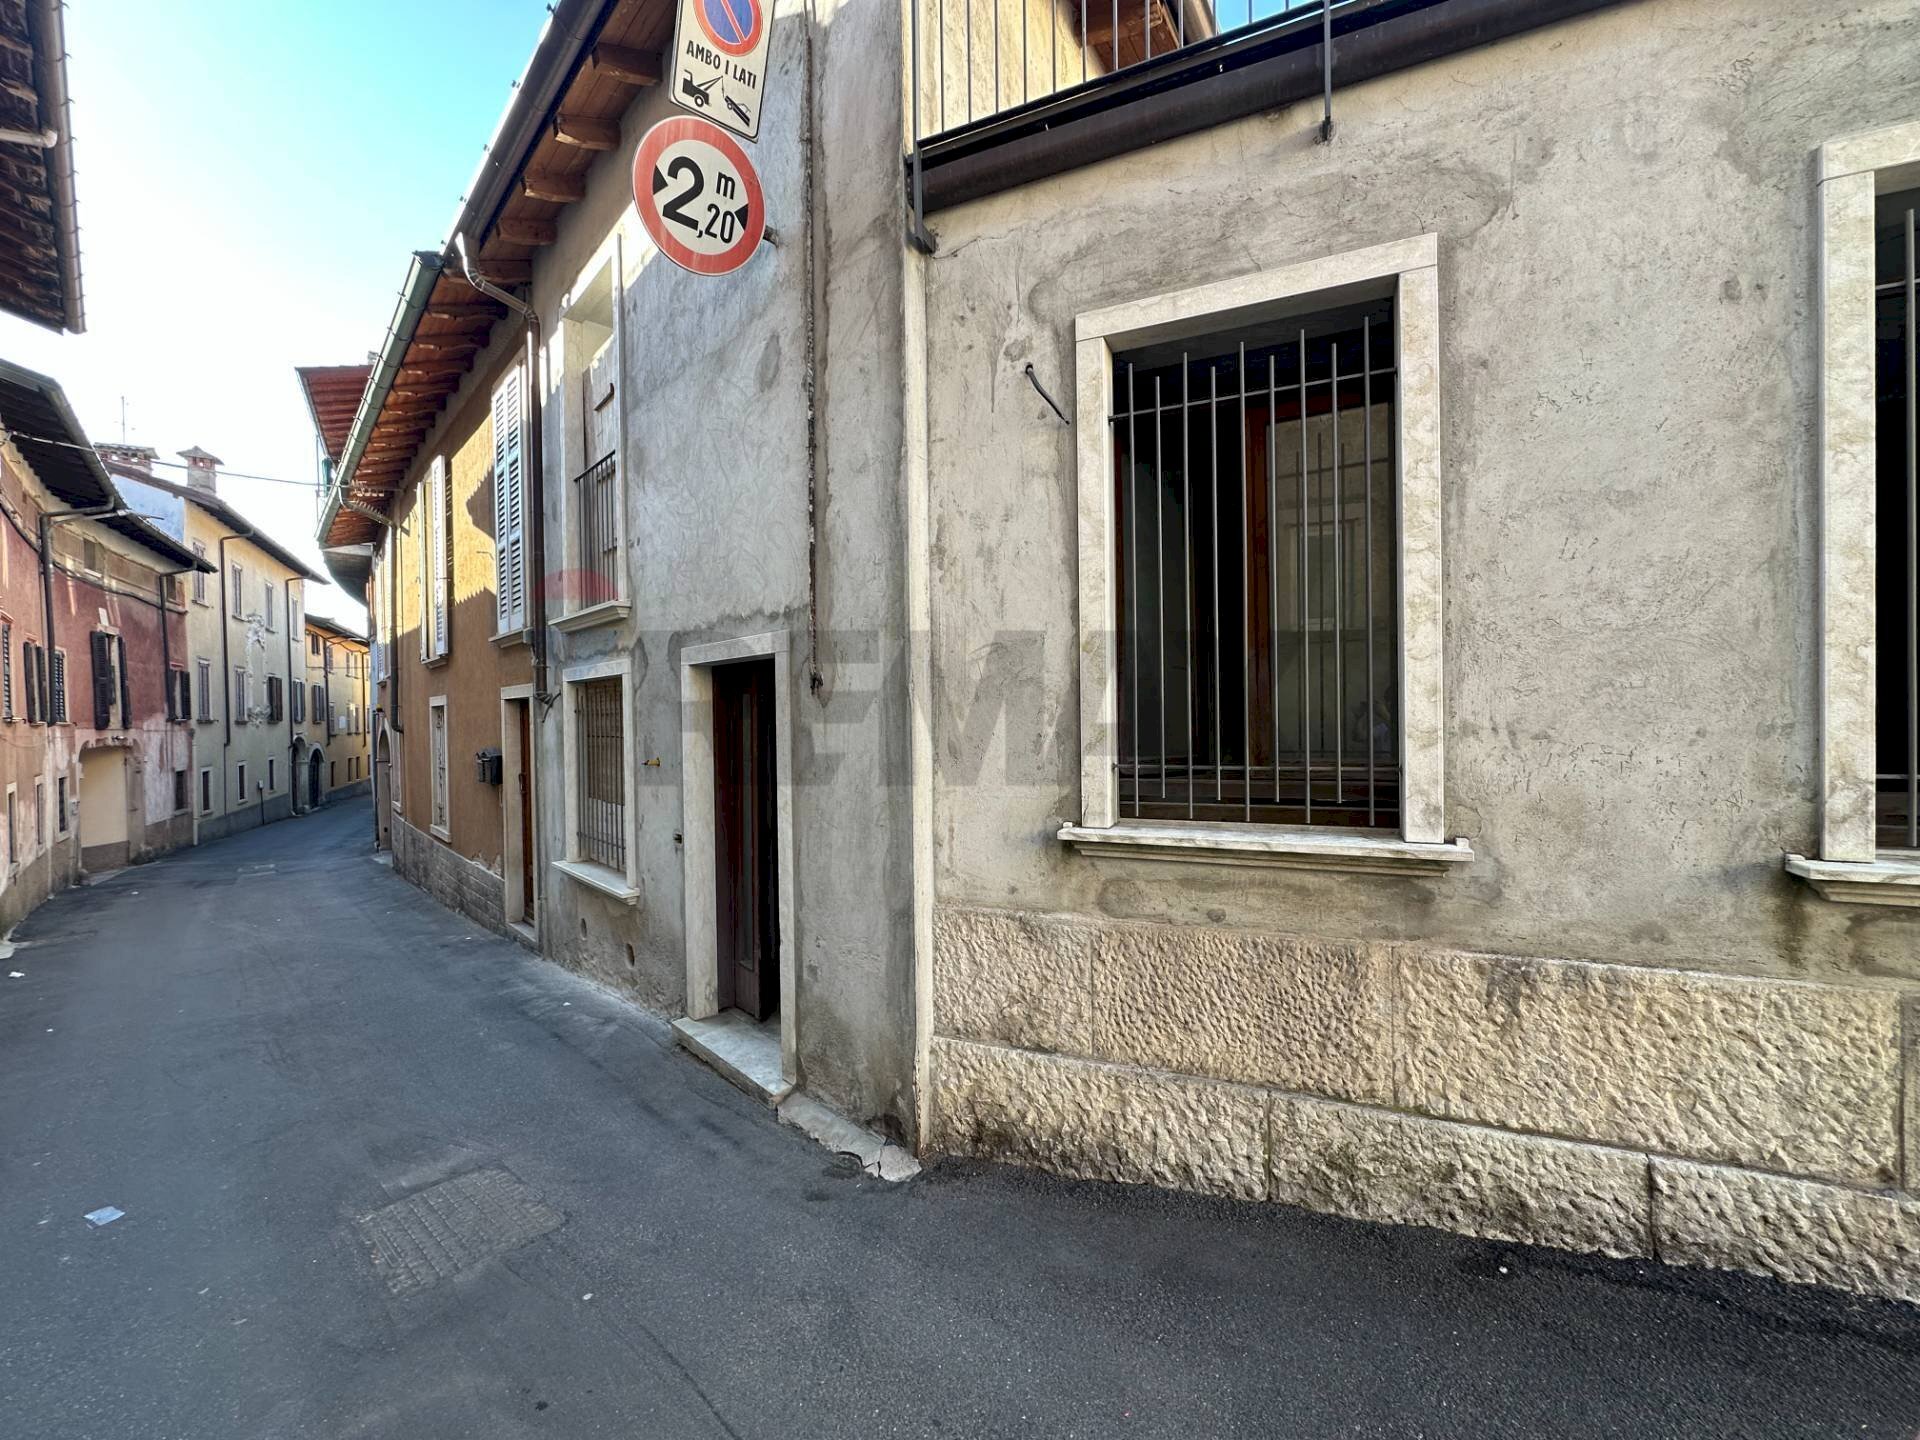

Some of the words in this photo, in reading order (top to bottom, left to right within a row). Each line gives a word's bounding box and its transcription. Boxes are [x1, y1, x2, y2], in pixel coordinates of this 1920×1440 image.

[686, 40, 721, 70] AMBO
[725, 61, 730, 76] I
[733, 64, 757, 90] LATI
